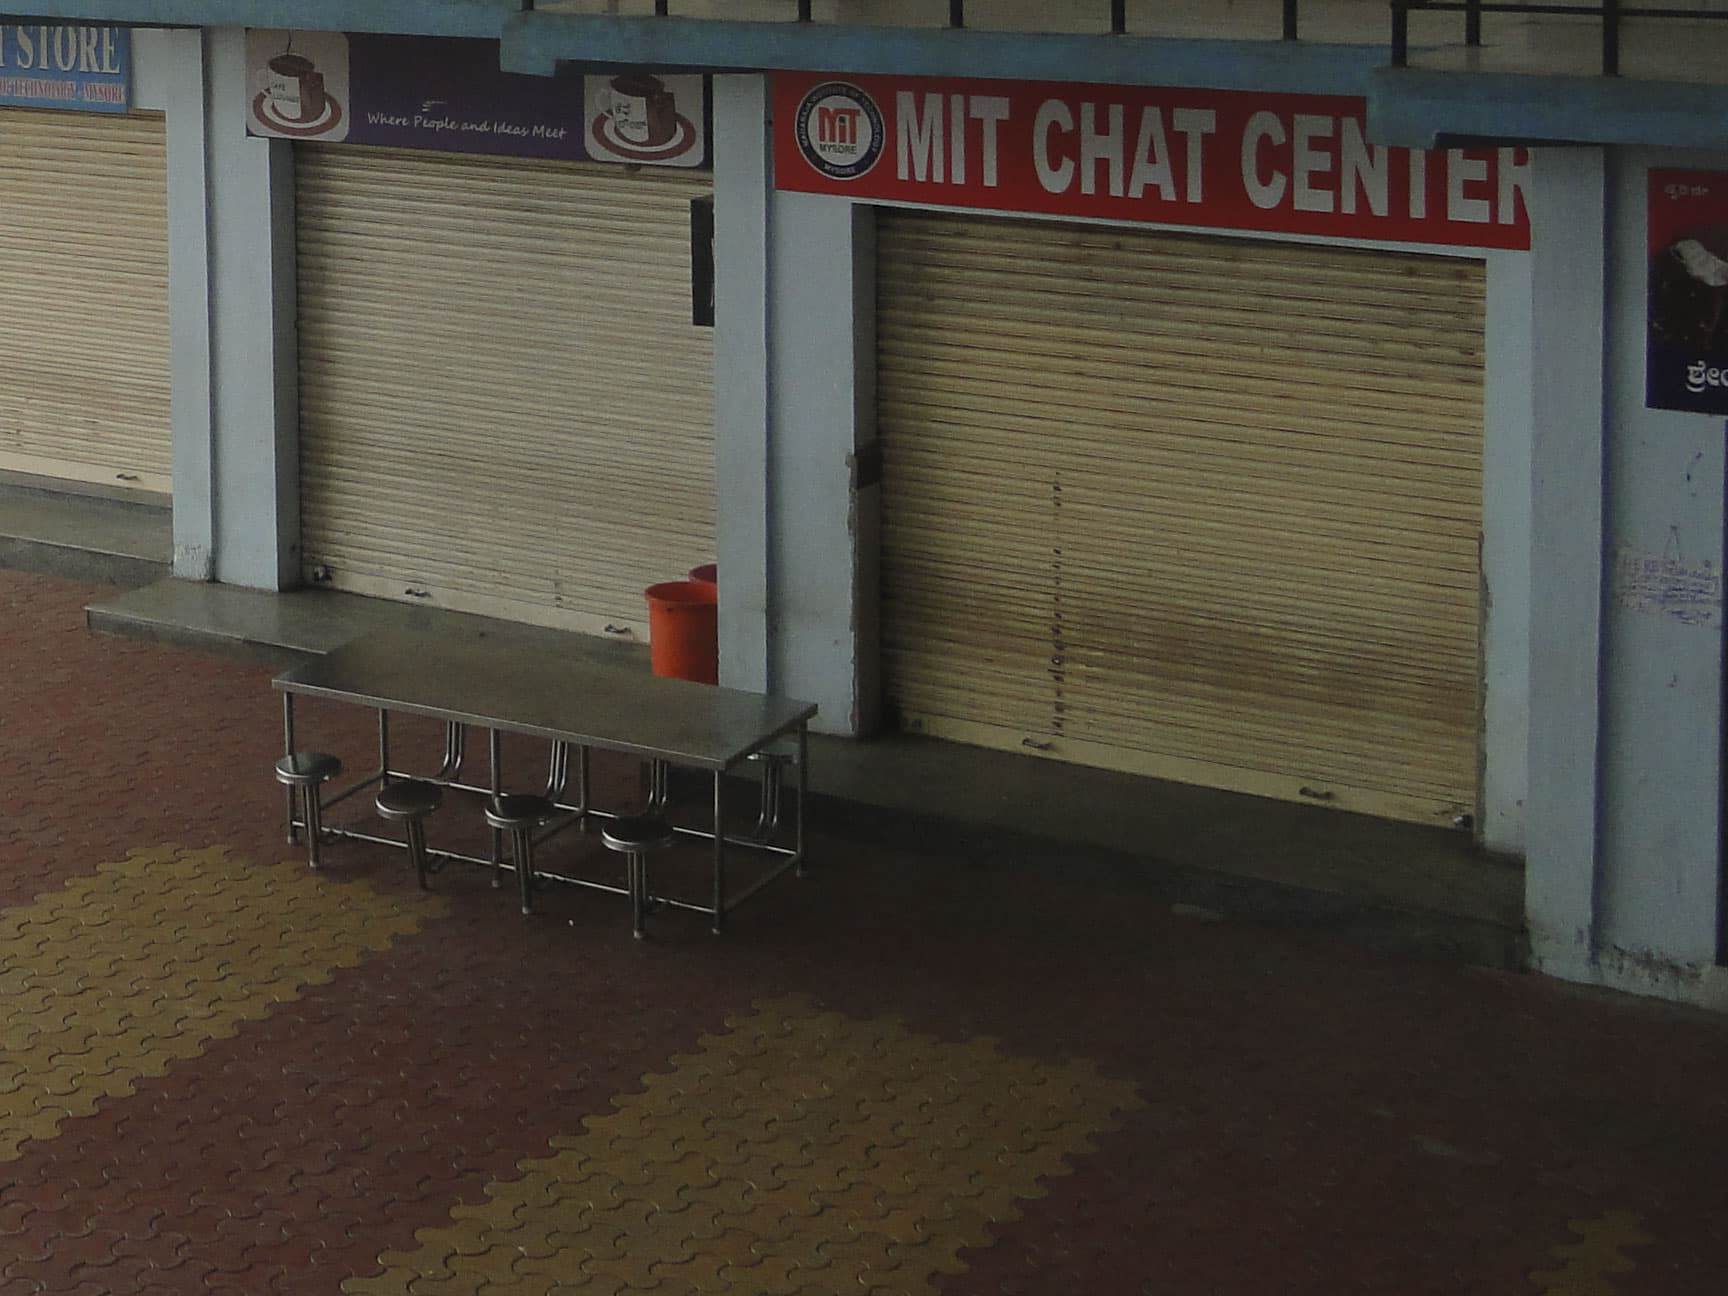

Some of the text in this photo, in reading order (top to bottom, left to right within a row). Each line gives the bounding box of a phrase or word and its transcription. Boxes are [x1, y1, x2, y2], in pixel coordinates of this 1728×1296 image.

[16, 25, 121, 74] STORE
[368, 112, 567, 140] Where People and Ideas Meet
[896, 91, 1532, 225] MIT CHAT CENTER
